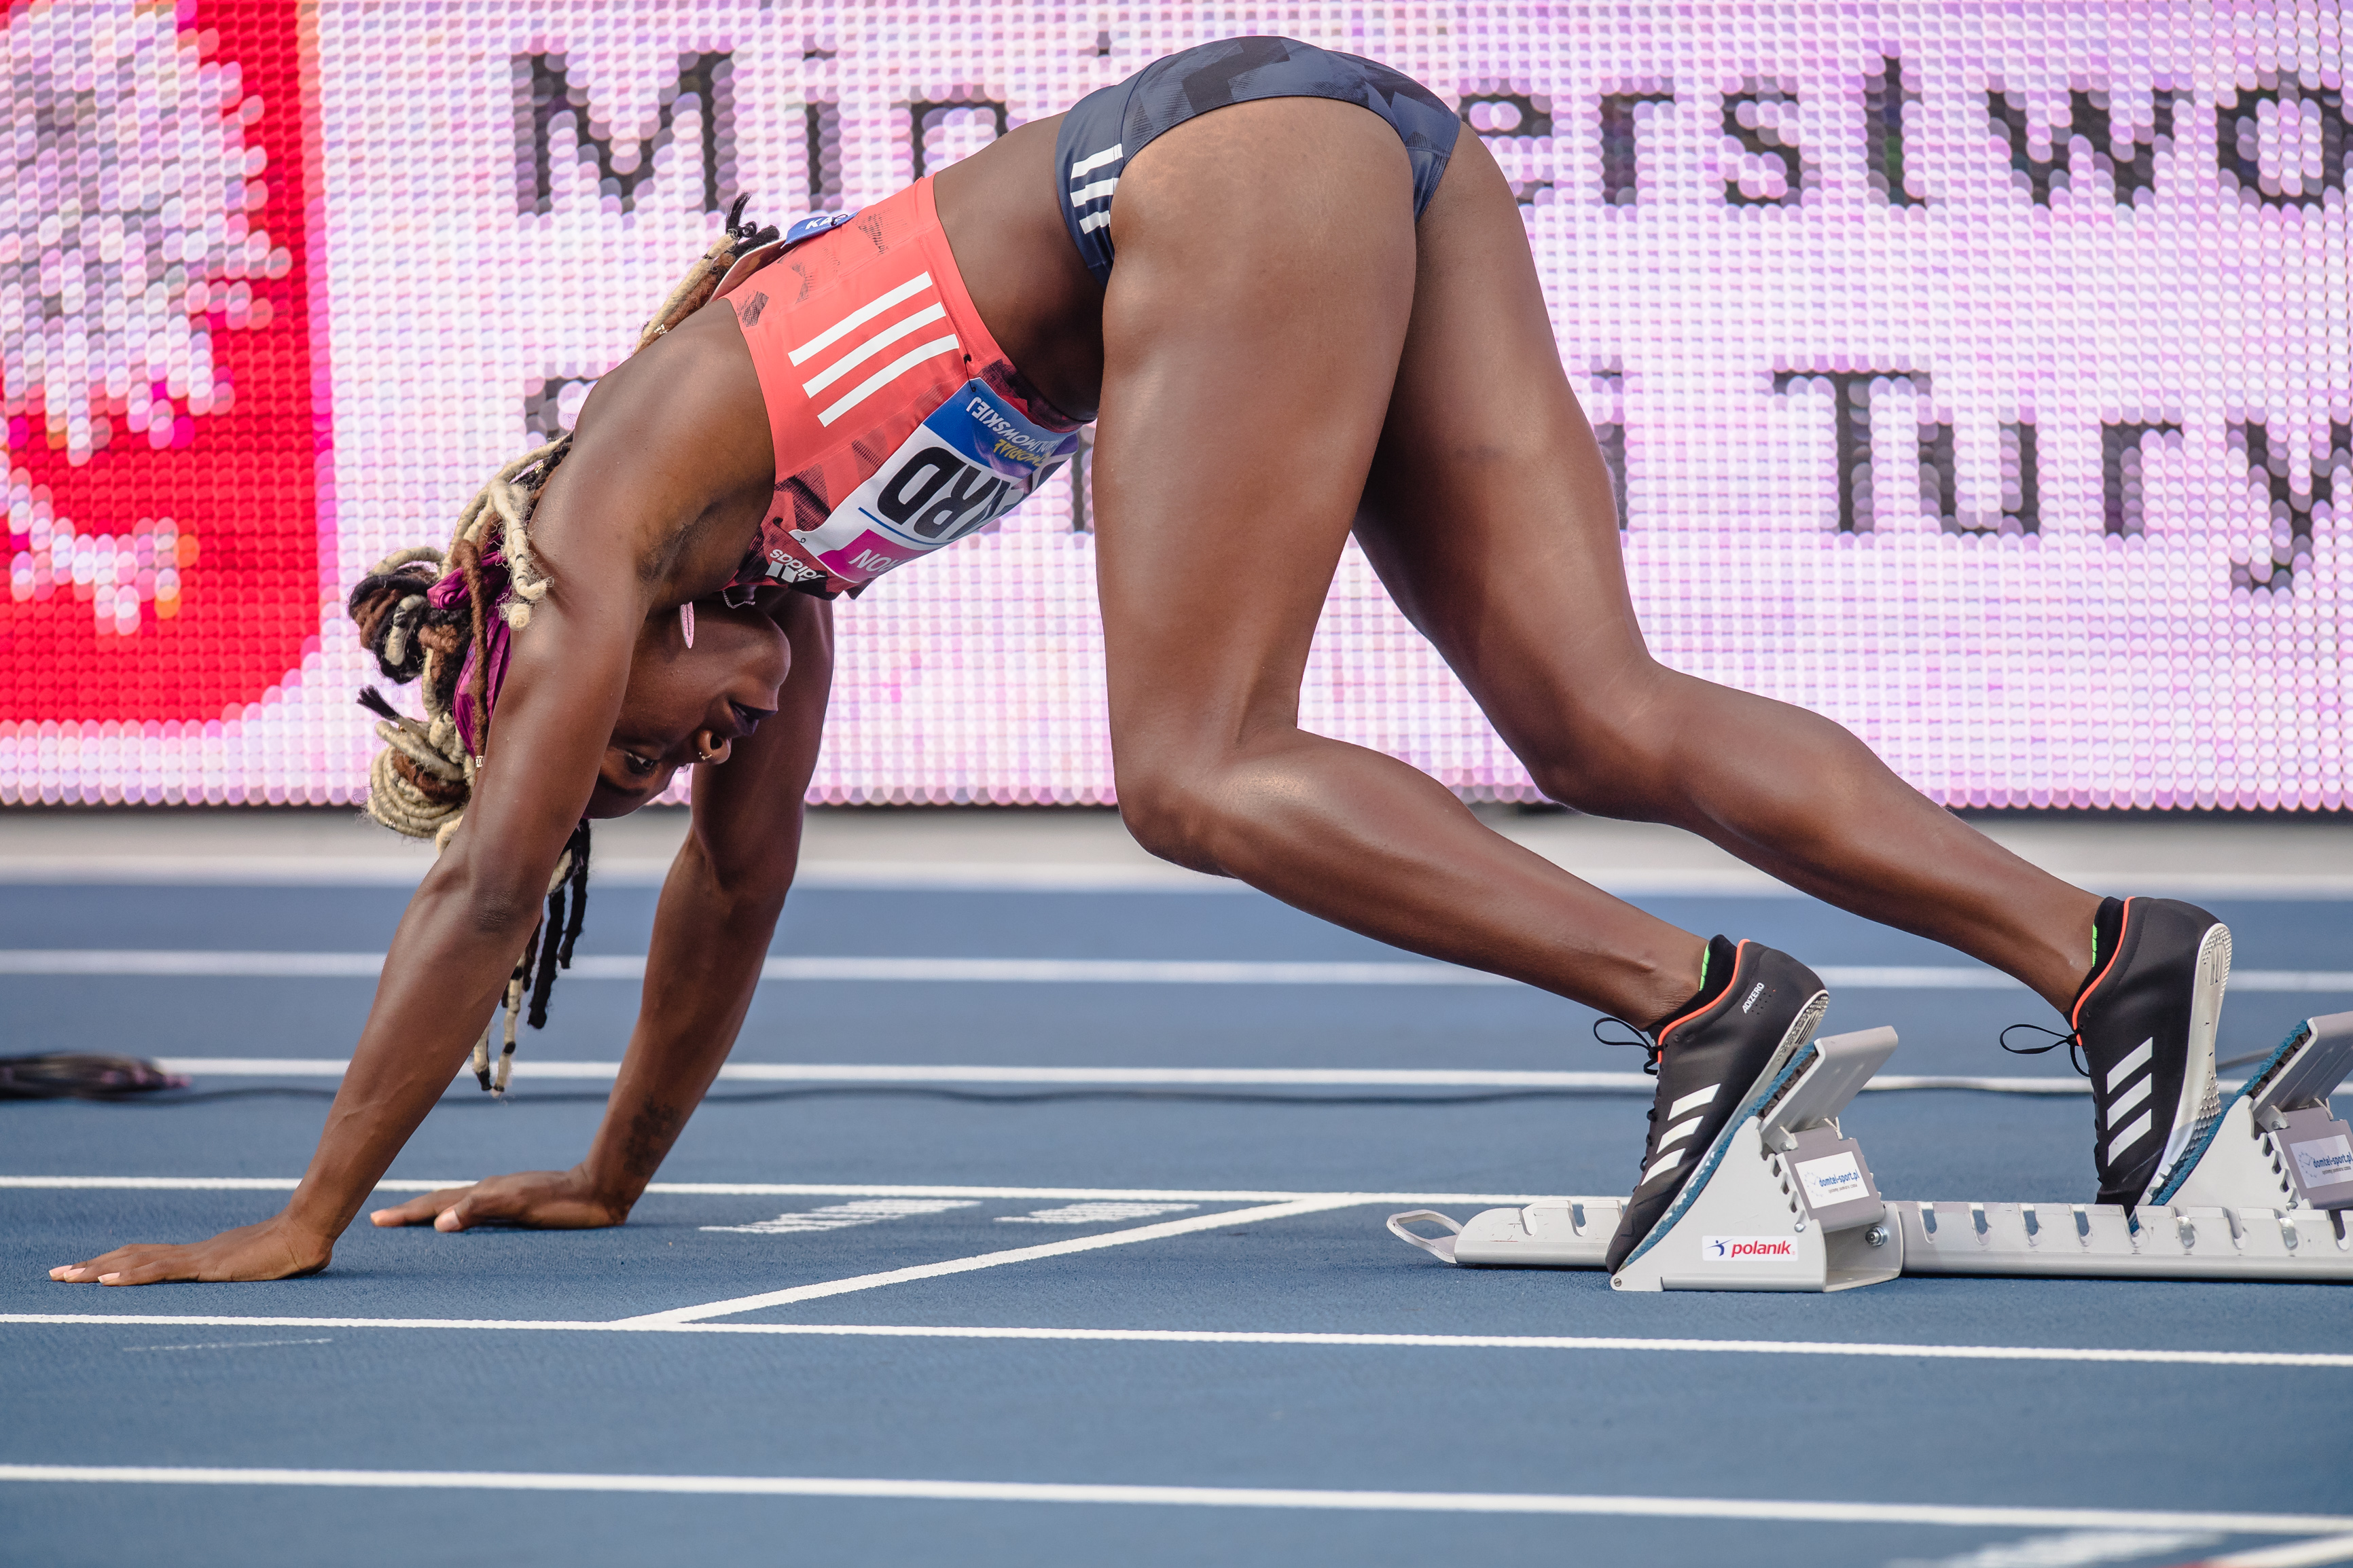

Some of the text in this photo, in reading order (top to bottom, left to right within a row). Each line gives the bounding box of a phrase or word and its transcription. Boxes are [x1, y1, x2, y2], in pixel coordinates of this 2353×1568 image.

[1742, 982, 1765, 1014] ADIZERO
[2313, 1151, 2353, 1168] domtel-sport.pl
[1818, 1169, 1860, 1187] domtel-sport.pl
[1731, 1240, 1791, 1258] polanik
